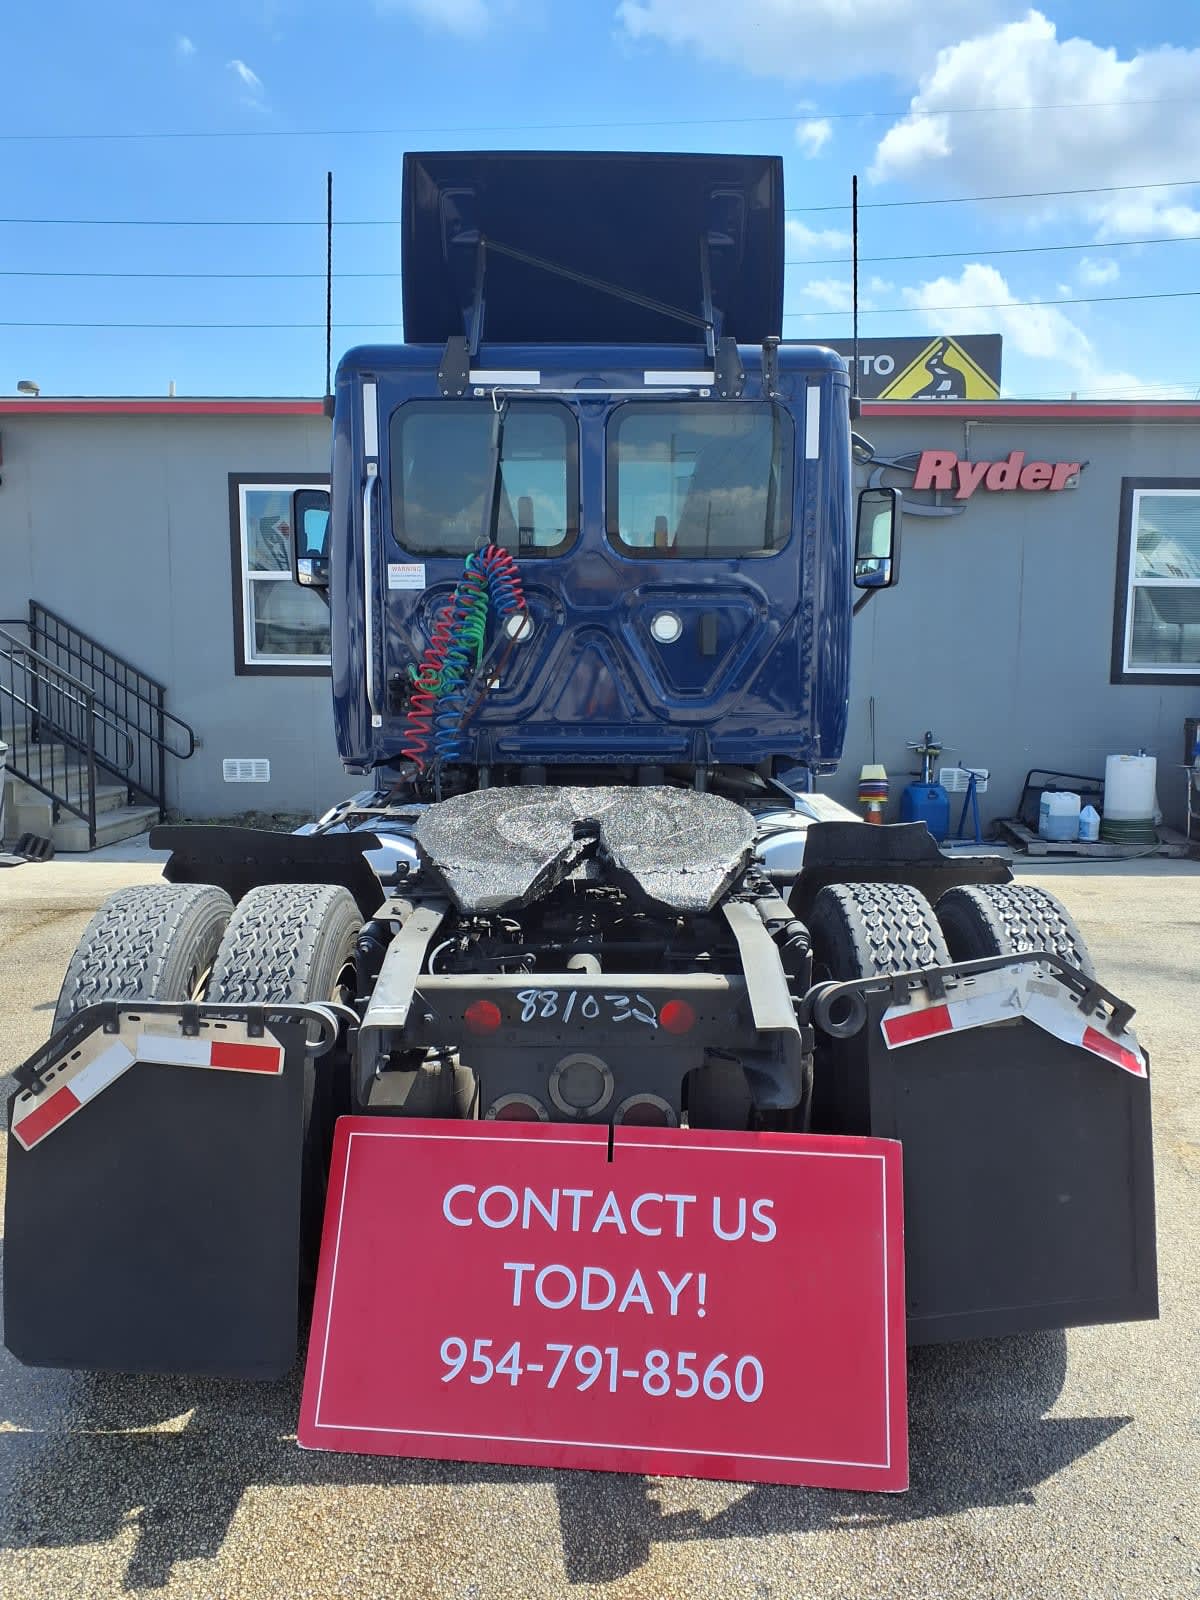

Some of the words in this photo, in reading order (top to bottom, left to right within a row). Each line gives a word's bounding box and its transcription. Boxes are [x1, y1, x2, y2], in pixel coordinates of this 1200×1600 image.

[912, 450, 1081, 499] Ryder
[516, 989, 658, 1028] 881032
[442, 1183, 697, 1238] CONTACT
[712, 1196, 777, 1243] US
[503, 1262, 707, 1318] TODAY!
[440, 1336, 764, 1403] 954-791-8560
